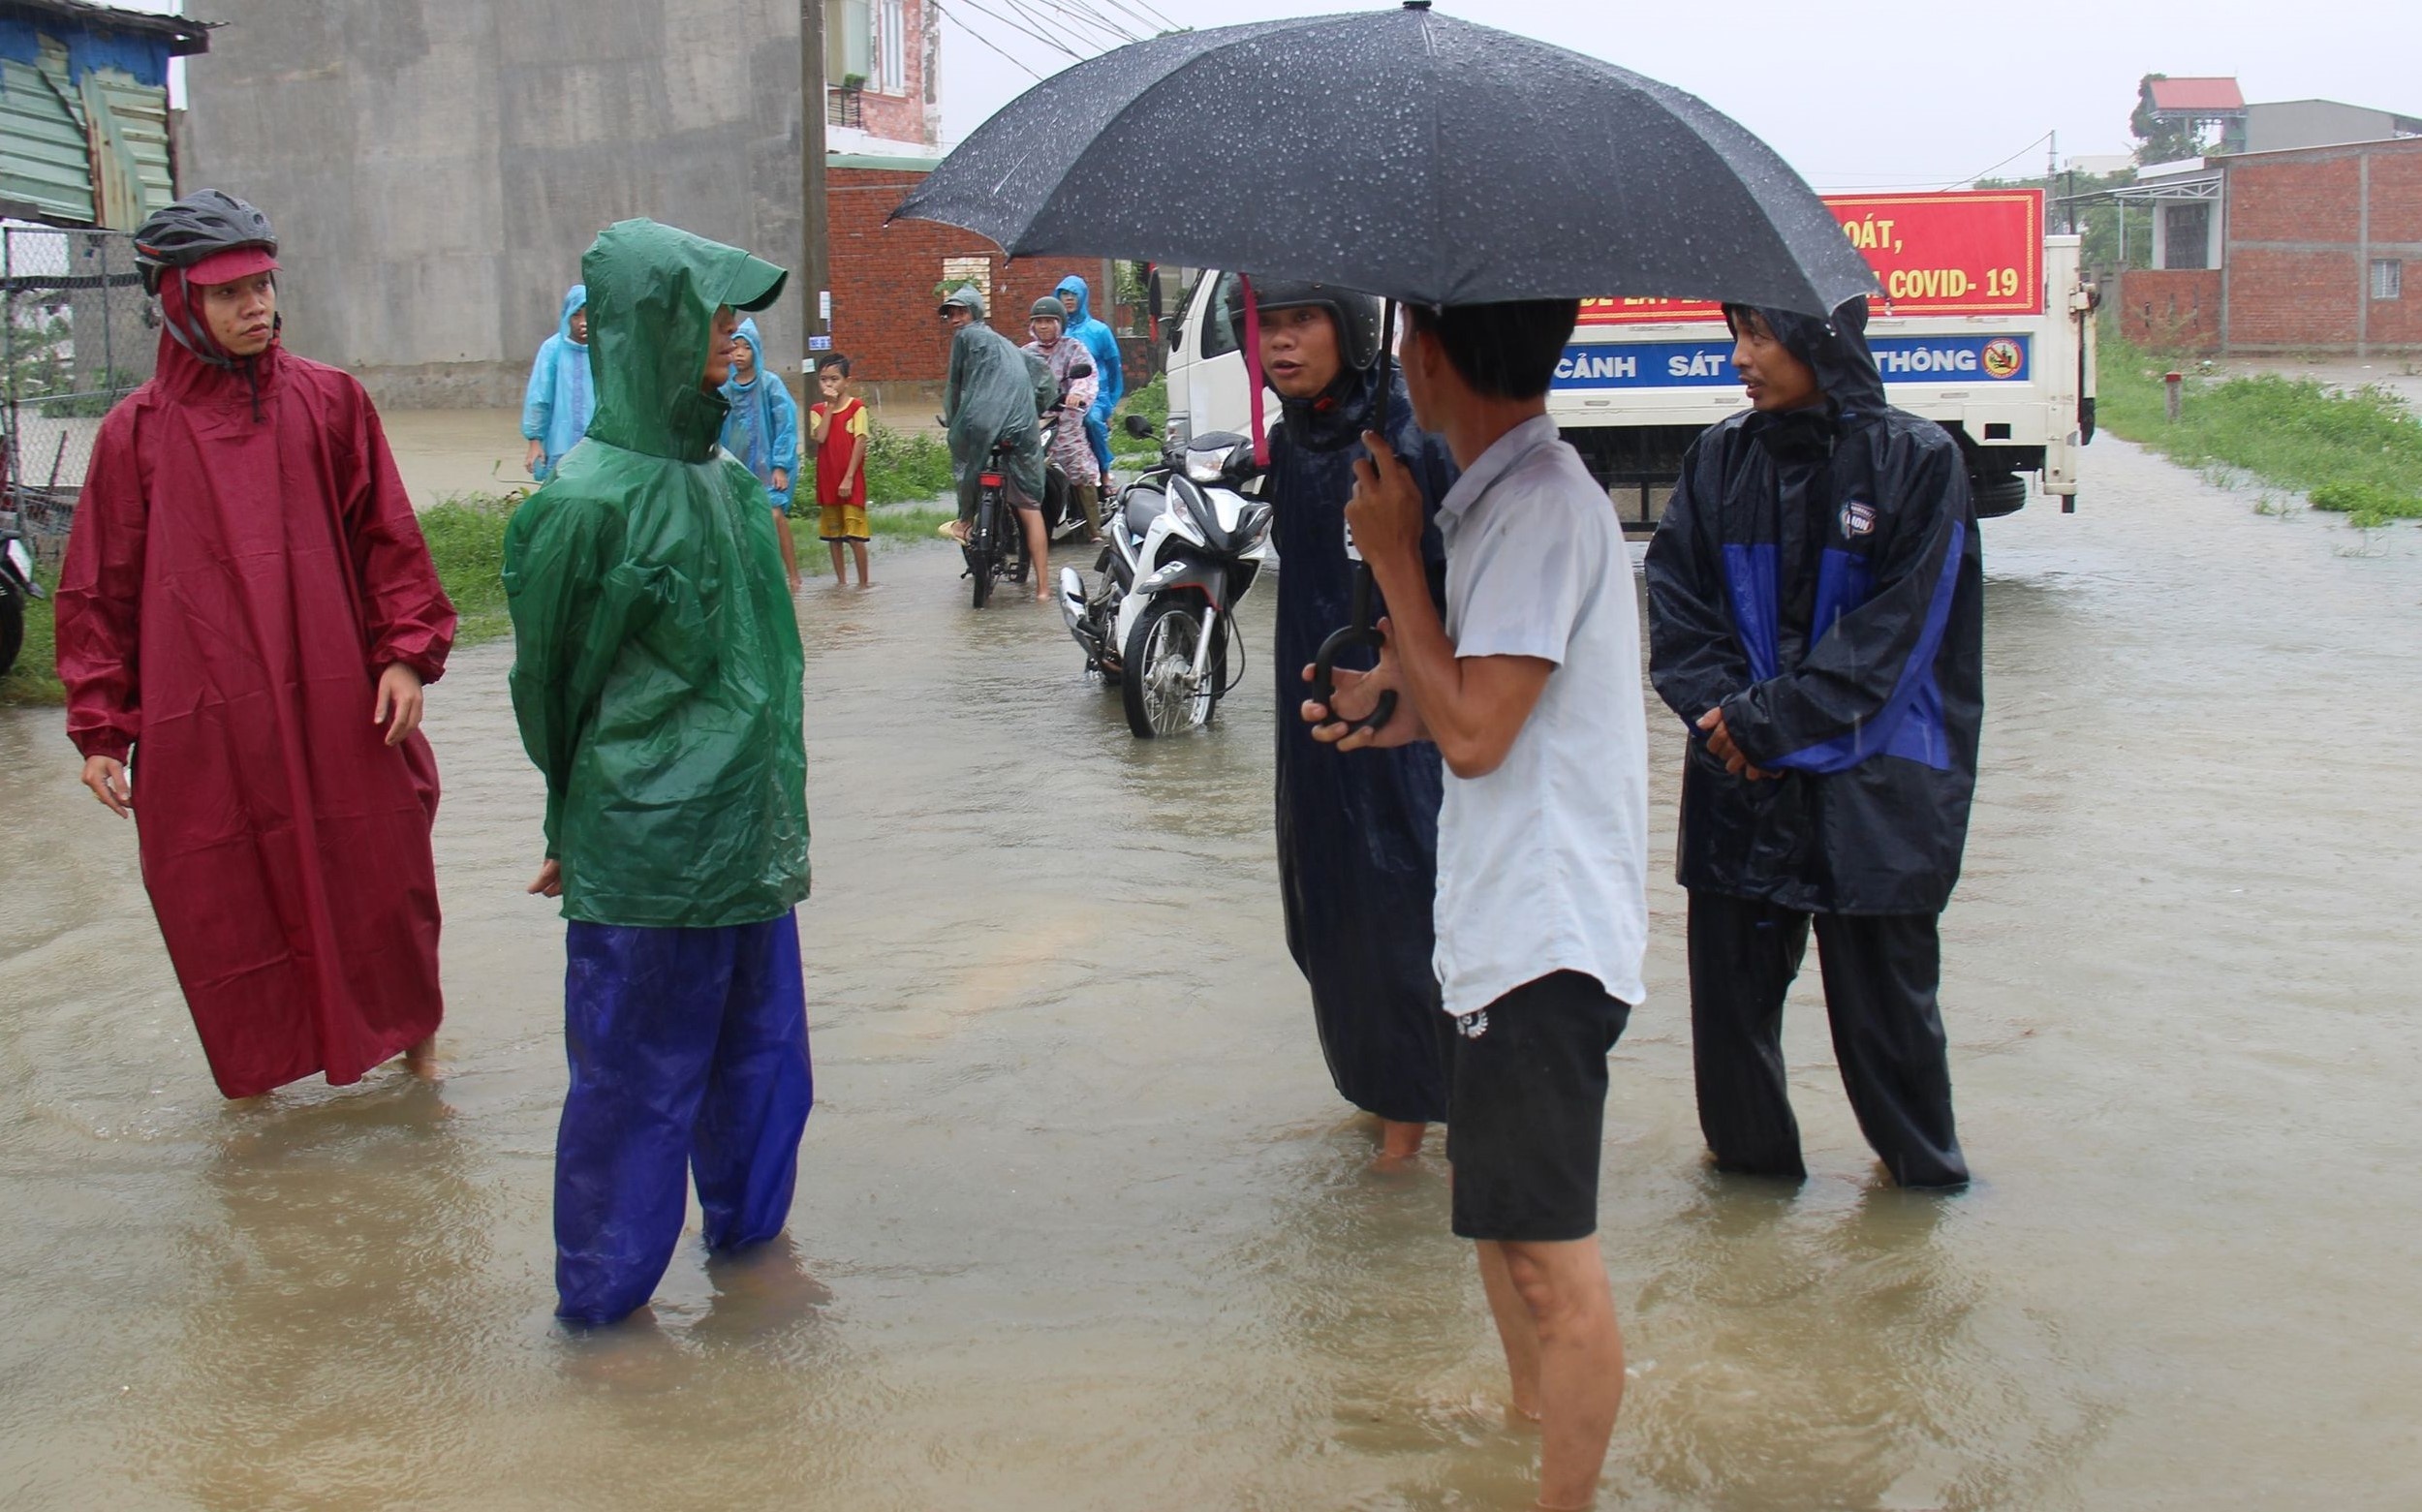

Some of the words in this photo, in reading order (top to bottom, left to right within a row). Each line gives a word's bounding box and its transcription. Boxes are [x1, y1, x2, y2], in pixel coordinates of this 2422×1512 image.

[1889, 269, 1976, 298] COVID-
[1987, 267, 2019, 296] 19
[1554, 353, 1636, 379] CẢNH
[1668, 351, 1725, 377] SÁT
[1871, 347, 1976, 373] THÔNG
[1846, 513, 1870, 531] LION
